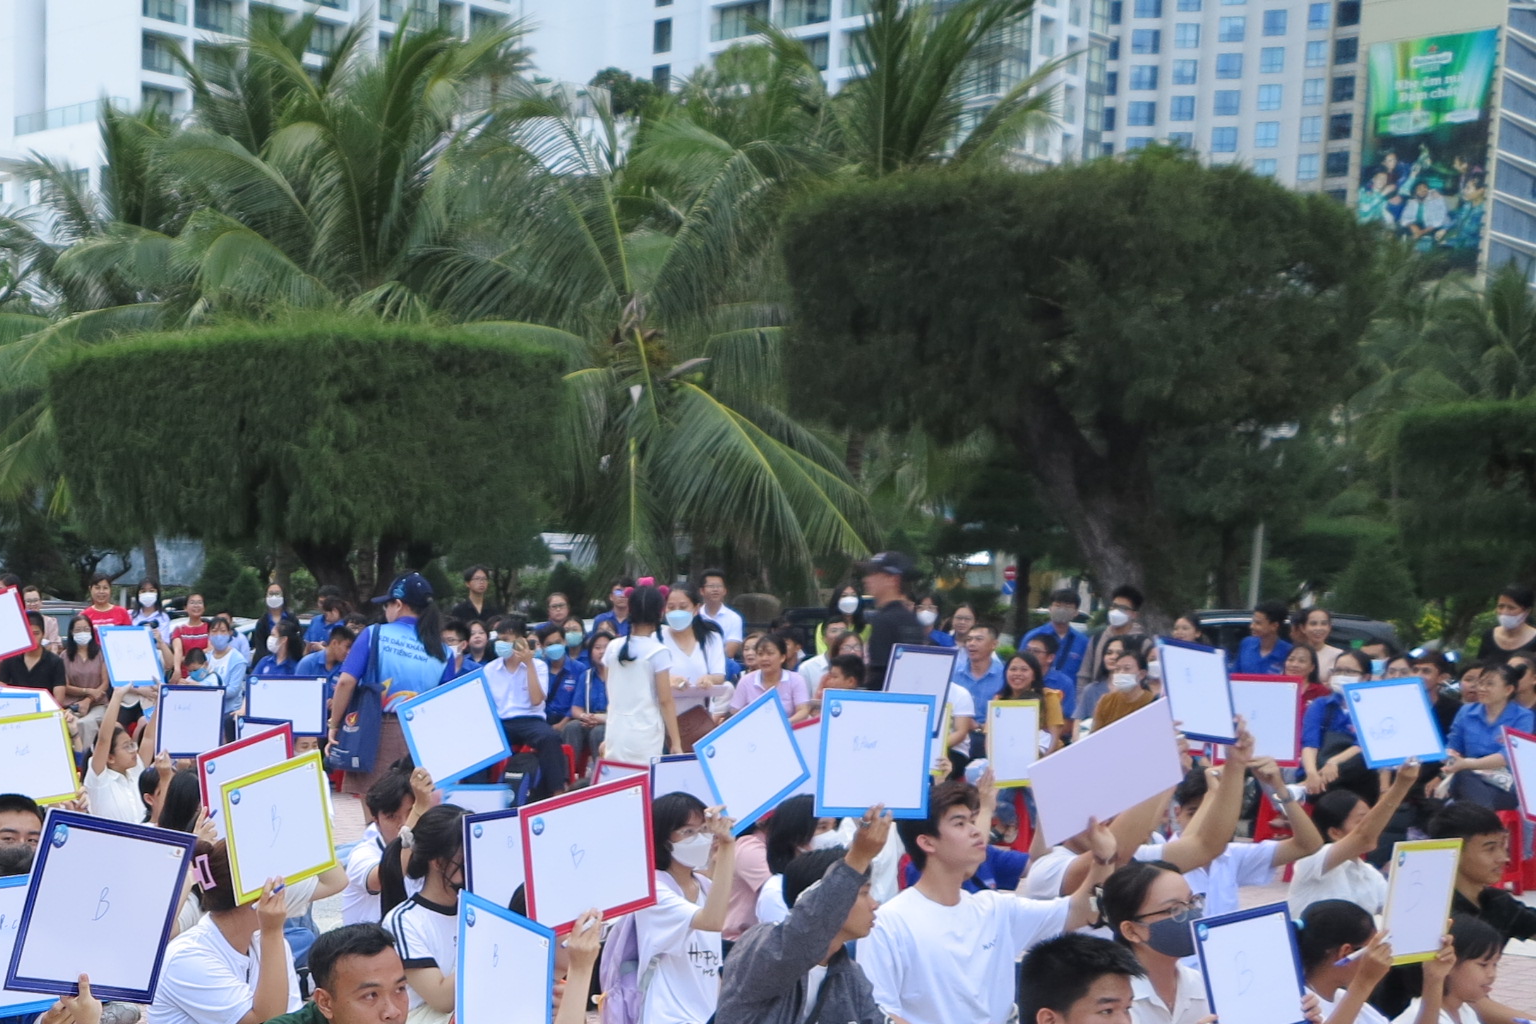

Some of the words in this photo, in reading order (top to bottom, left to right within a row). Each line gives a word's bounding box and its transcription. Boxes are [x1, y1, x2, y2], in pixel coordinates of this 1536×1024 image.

[413, 655, 429, 663] ANH
[569, 843, 585, 869] B
[92, 886, 110, 922] B
